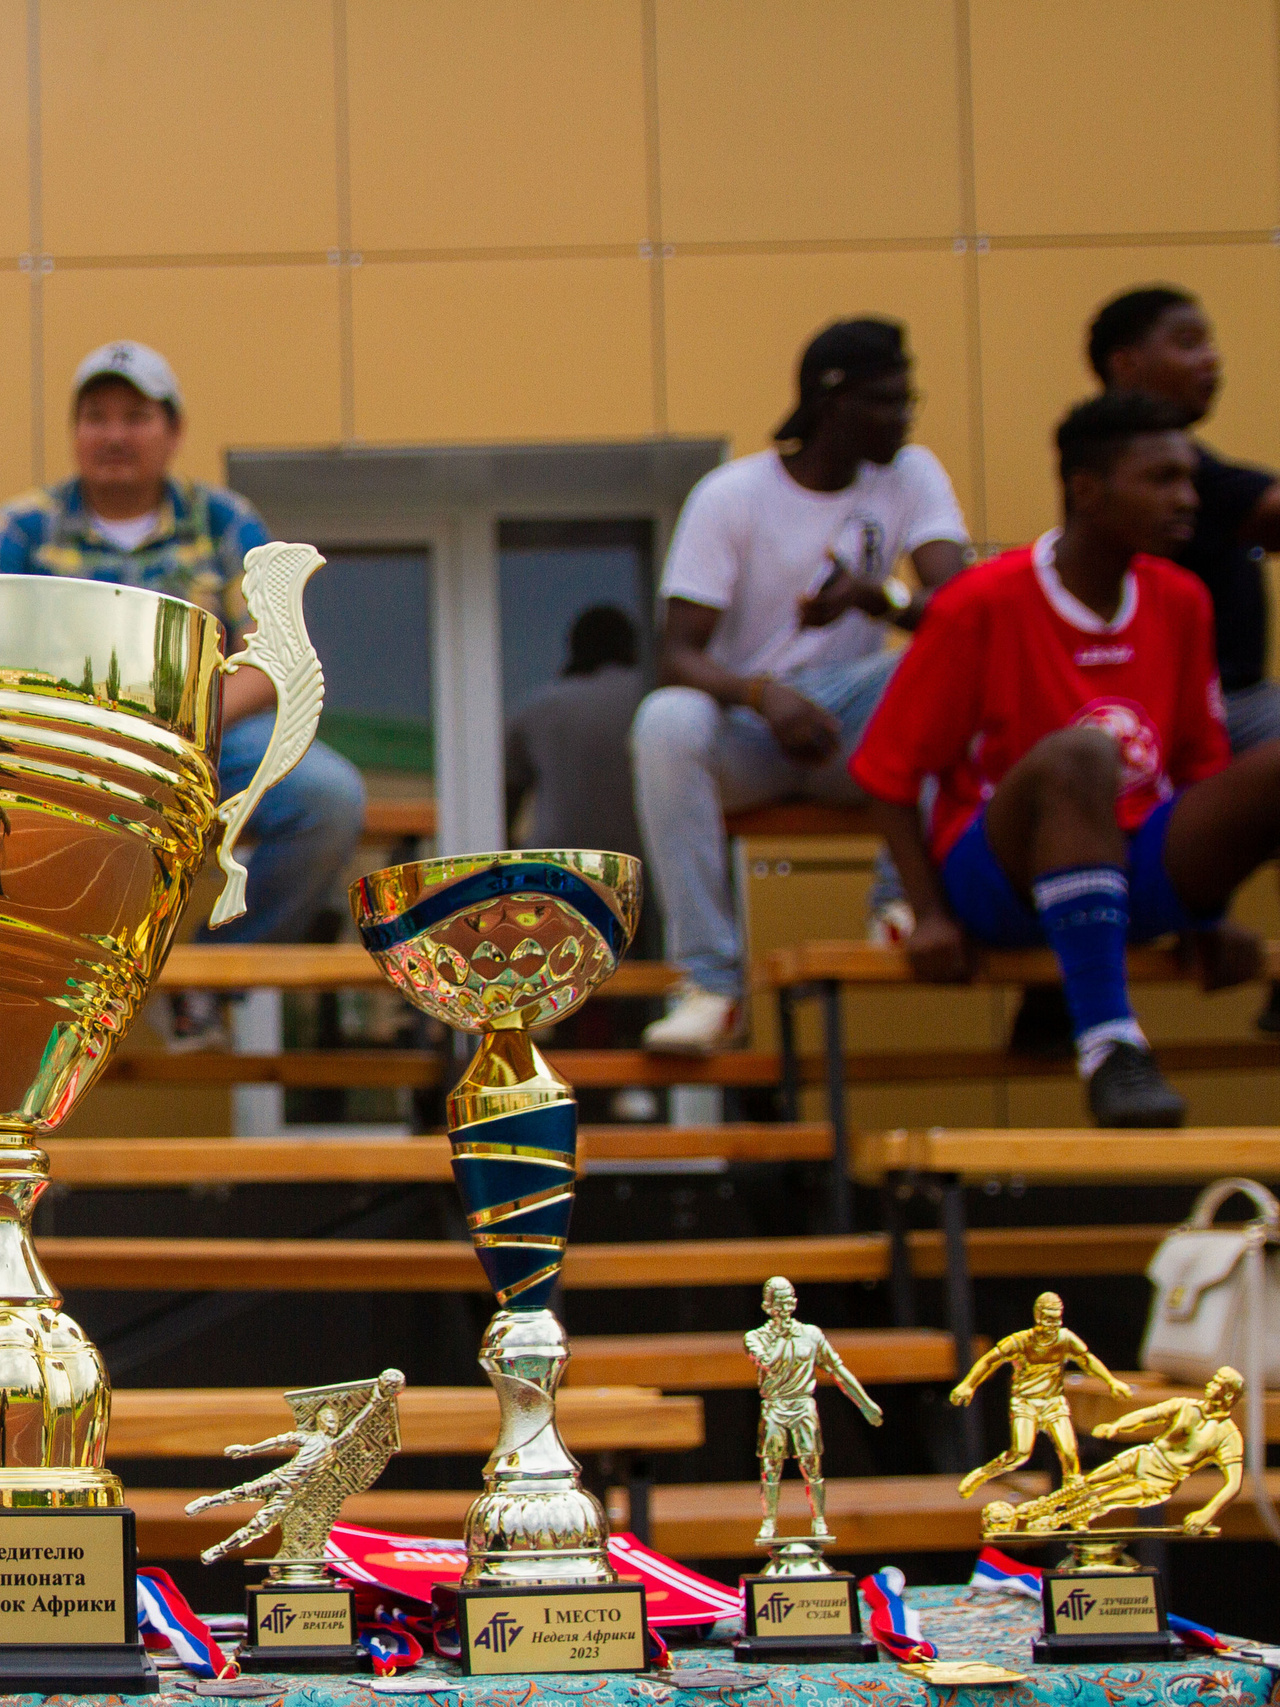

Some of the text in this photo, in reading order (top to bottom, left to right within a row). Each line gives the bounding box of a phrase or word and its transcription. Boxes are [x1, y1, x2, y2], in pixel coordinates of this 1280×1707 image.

[31, 1595, 116, 1617] Африки
[797, 1598, 847, 1608] ЛУЧШИЙ
[299, 1609, 347, 1619] ЛУЧШИЙ
[556, 1609, 621, 1624] МЕСТО
[806, 1610, 840, 1619] СУДЬЯ
[302, 1621, 345, 1630] ВРАТАРЬ
[532, 1630, 636, 1645] Неделя Африки
[570, 1647, 600, 1659] 2023
